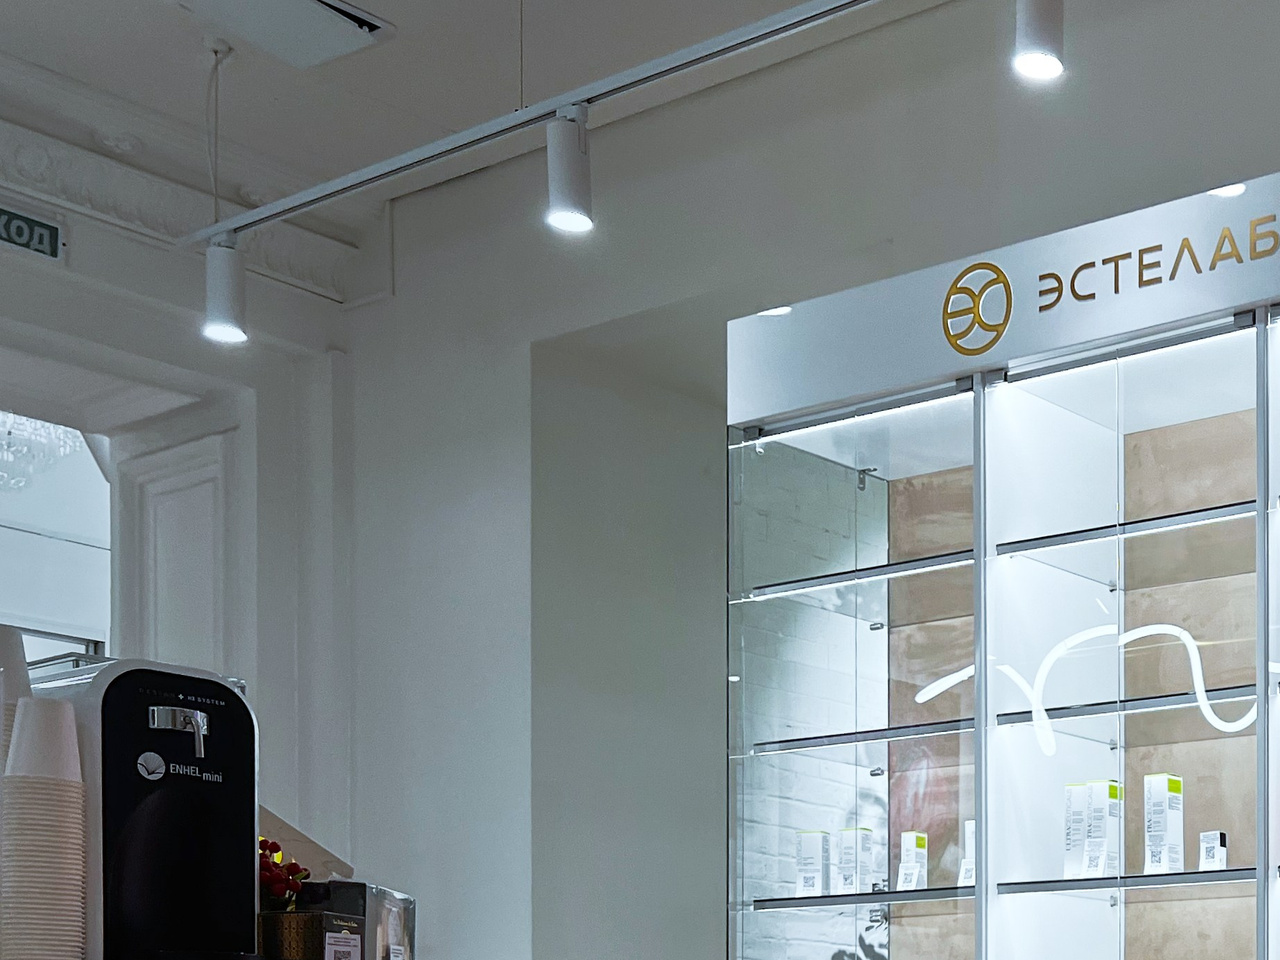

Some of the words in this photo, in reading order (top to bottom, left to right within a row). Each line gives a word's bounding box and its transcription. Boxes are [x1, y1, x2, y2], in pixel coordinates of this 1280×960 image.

[1039, 214, 1280, 313] ЭСТЕЛАБ
[170, 763, 202, 777] ENHEL
[202, 771, 223, 783] mini
